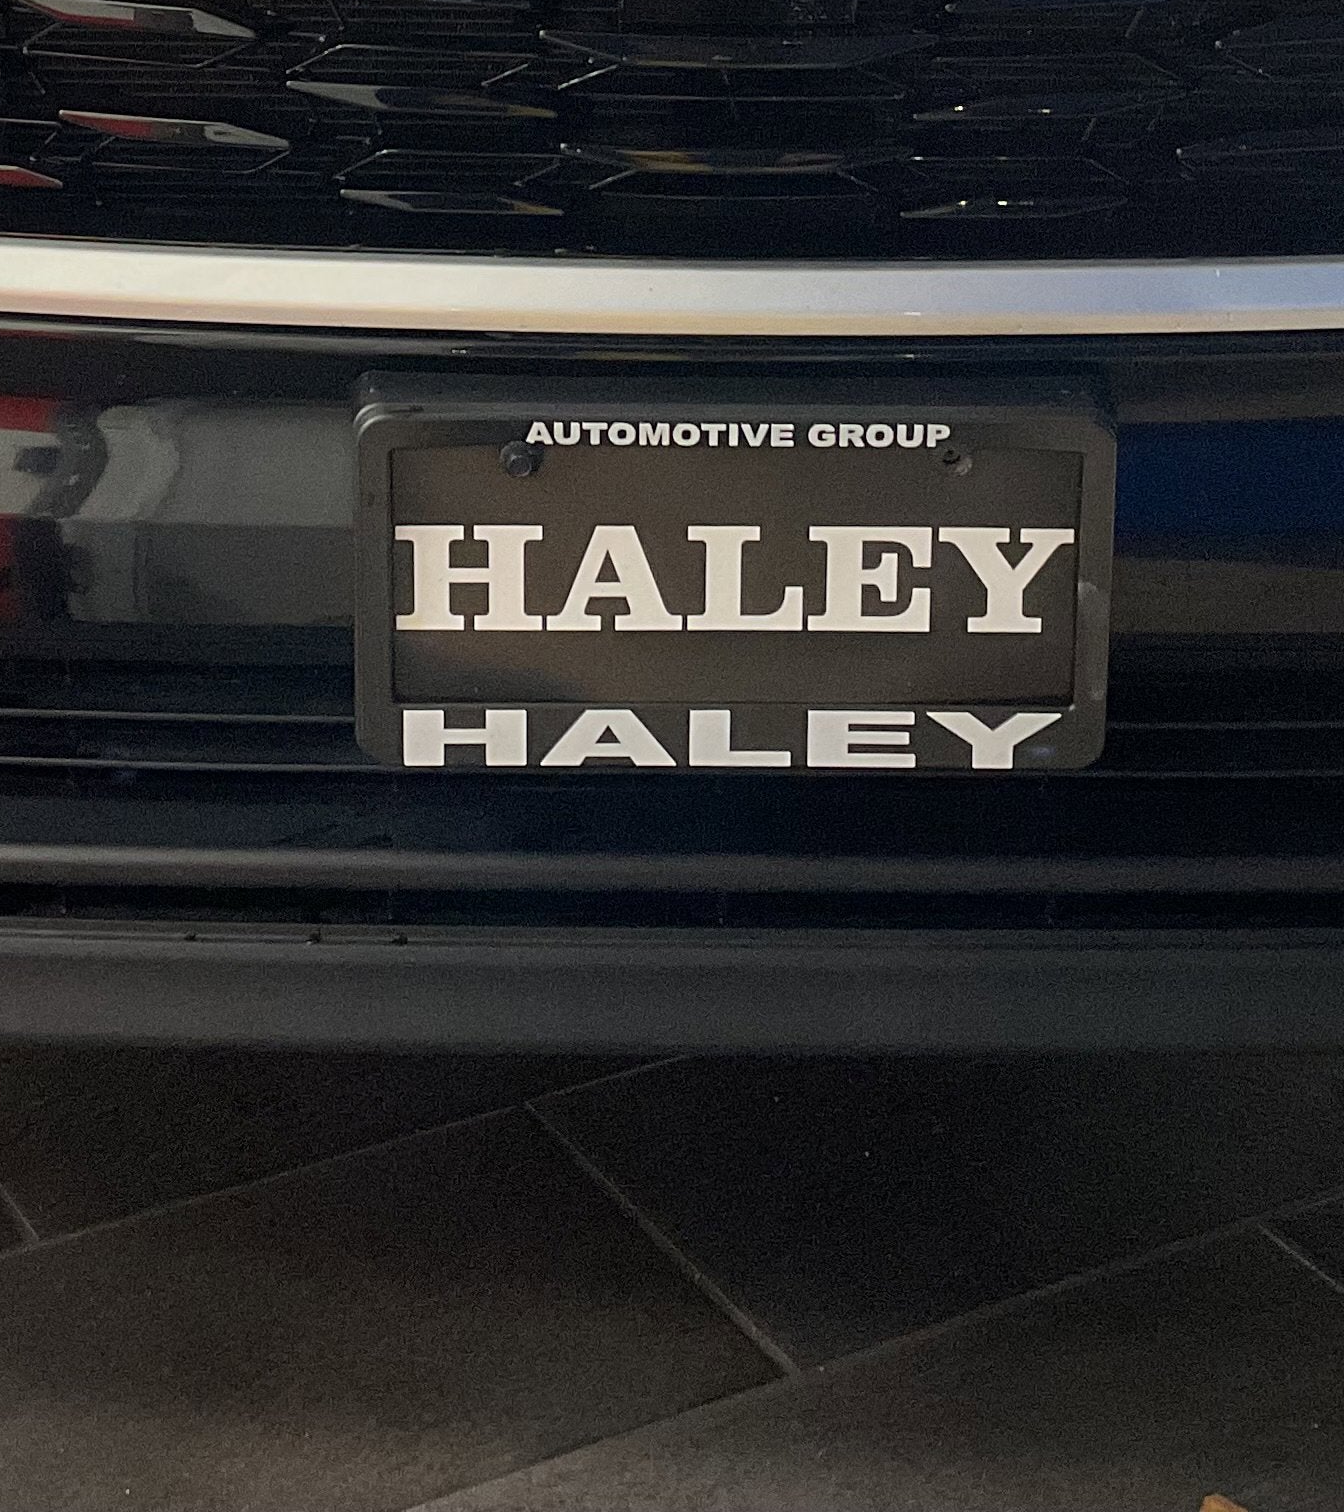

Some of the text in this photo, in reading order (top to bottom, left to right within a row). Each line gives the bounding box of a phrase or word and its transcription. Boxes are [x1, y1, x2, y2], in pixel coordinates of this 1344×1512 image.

[525, 420, 952, 449] AUTOMOTIVE GROUP
[394, 524, 1076, 634] HALEY
[402, 706, 1063, 769] HALEY
